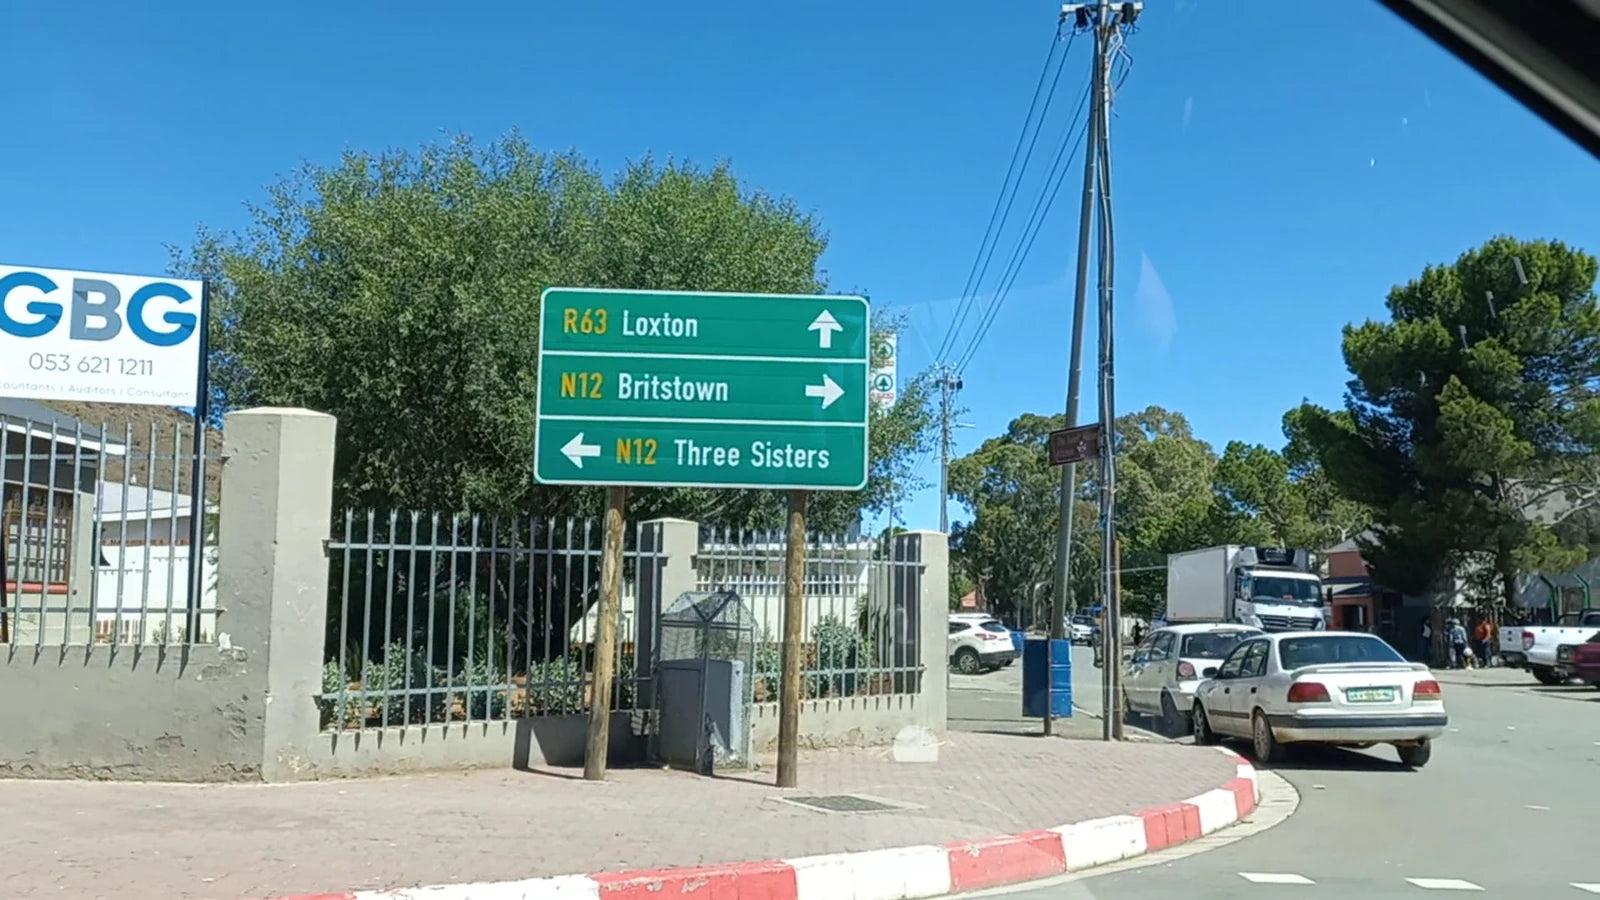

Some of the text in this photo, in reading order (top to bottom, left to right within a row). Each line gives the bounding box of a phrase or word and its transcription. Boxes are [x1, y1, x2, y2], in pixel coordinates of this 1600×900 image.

[0, 271, 197, 347] GBG
[563, 308, 699, 338] R63 Loxton
[29, 352, 153, 376] 053 621 1211
[68, 384, 116, 396] Auditors
[560, 372, 728, 402] N12 Britstown
[615, 438, 831, 470] N12 Three Sisters
